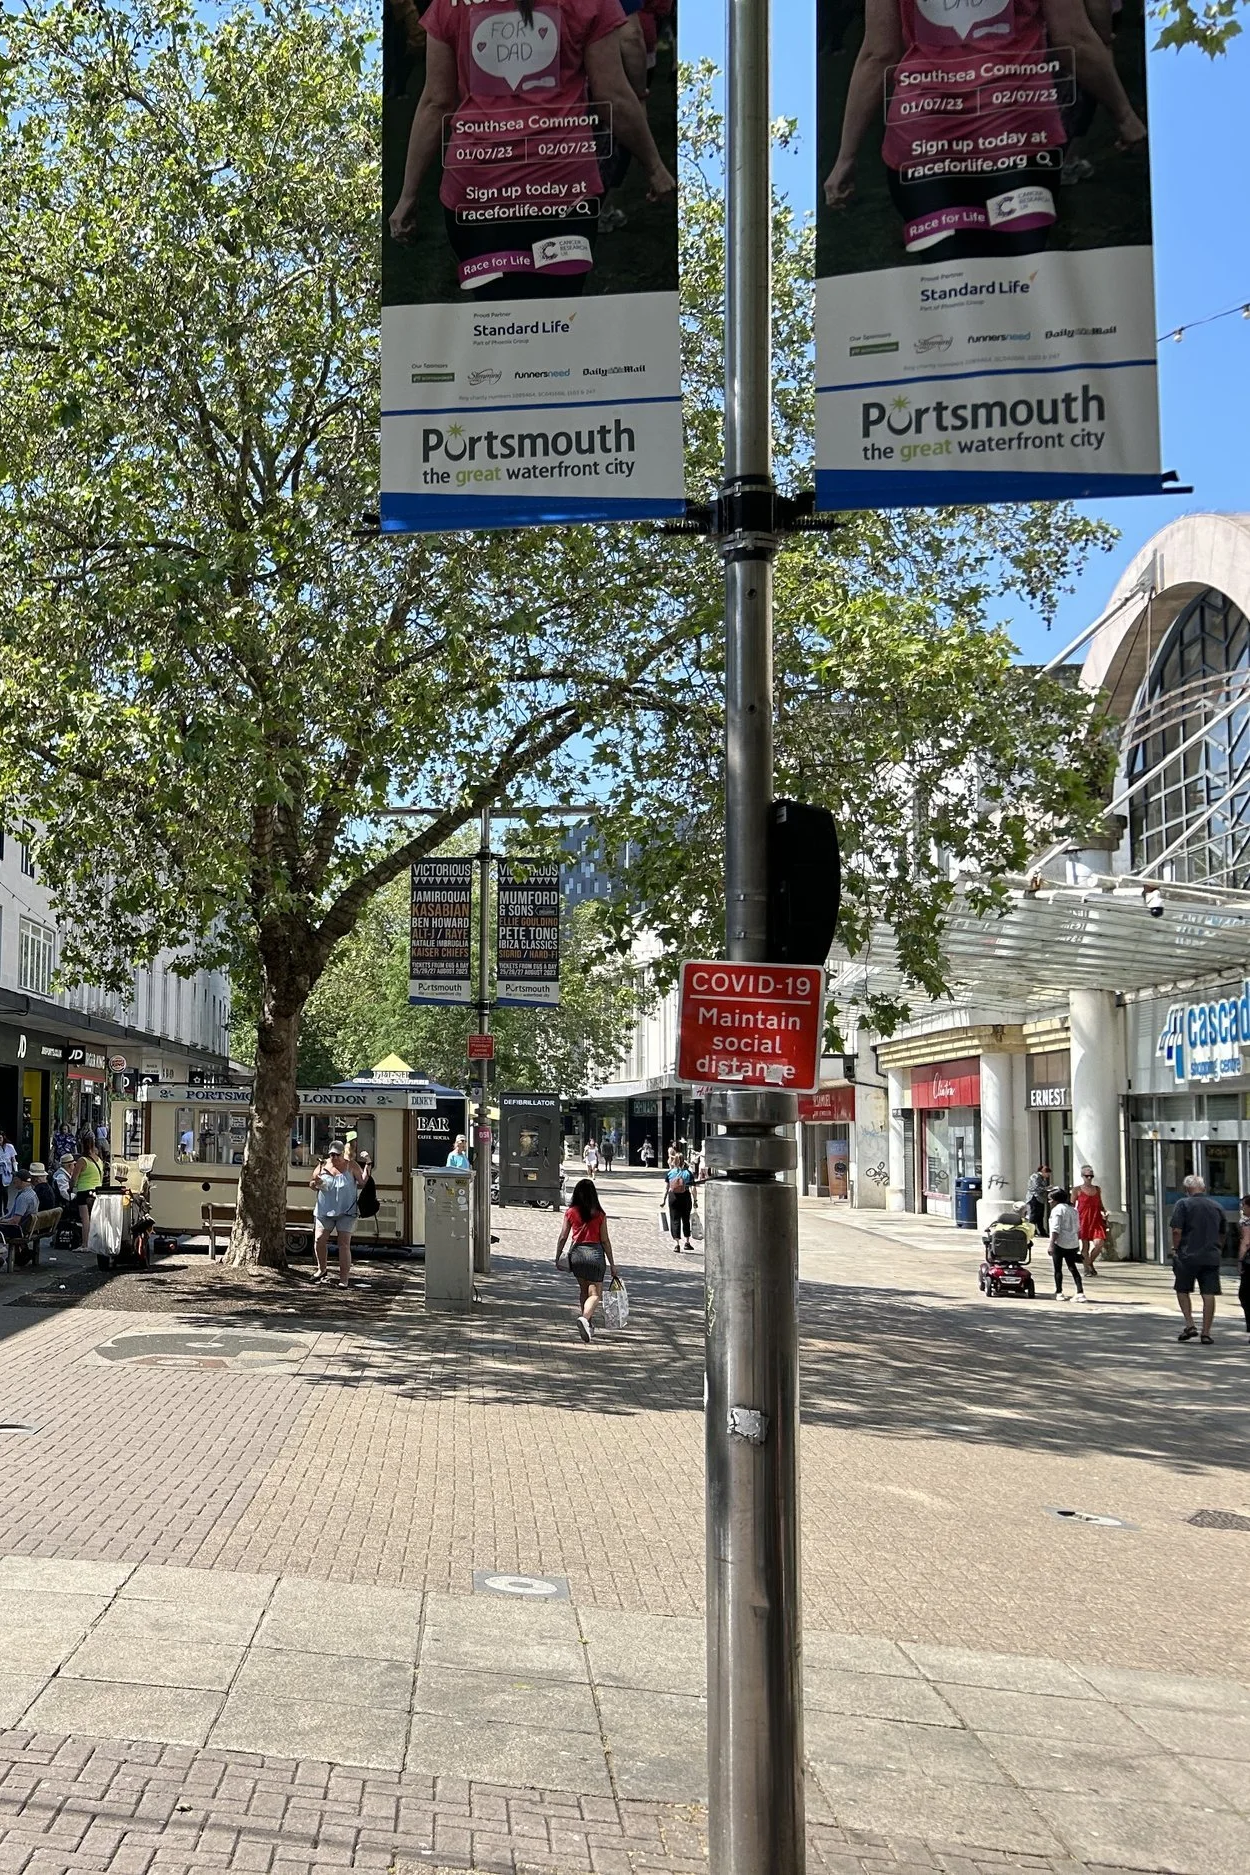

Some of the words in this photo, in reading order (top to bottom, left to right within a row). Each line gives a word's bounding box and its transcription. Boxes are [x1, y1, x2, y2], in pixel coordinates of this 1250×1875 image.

[491, 20, 526, 40] FOR
[497, 42, 533, 62] DAD
[900, 68, 976, 86] Southsea
[980, 60, 1060, 77] Common
[992, 88, 1058, 104] 02/07/23
[901, 98, 963, 114] 01/07/23
[455, 118, 524, 134] Southsea
[528, 113, 599, 129] Common
[538, 141, 597, 155] 02/07/23
[911, 140, 948, 155] Sign
[952, 139, 974, 152] up
[978, 131, 1027, 149] today
[1030, 131, 1048, 143] at
[456, 146, 513, 160] 01/07/23
[907, 154, 1027, 179] raceforlife.org
[466, 186, 498, 202] Sign
[502, 186, 521, 198] up
[525, 181, 568, 197] today
[571, 181, 587, 193] at
[462, 203, 568, 221] raceforlife.org
[909, 220, 939, 237] Race
[942, 214, 959, 224] for
[963, 211, 986, 222] Life
[463, 261, 489, 275] Race
[492, 257, 507, 267] for
[510, 255, 530, 266] Life
[920, 281, 996, 302] Standard
[999, 279, 1030, 294] Life
[473, 321, 539, 336] Standard
[542, 320, 570, 333] Life
[1045, 328, 1075, 339] Daily
[967, 331, 1031, 344] runnersneed
[515, 368, 570, 379] runnersneed
[583, 368, 608, 377] Daily
[624, 365, 646, 373] Mail
[862, 384, 1106, 438] Portsmouth
[422, 419, 635, 463] Portsmouth
[862, 443, 894, 461] the
[900, 438, 952, 462] great
[958, 432, 1064, 454] waterfront
[1070, 428, 1106, 450] city
[422, 468, 450, 484] the
[456, 466, 501, 487] great
[506, 460, 600, 480] waterfront
[605, 458, 635, 477] city
[413, 863, 471, 876] VICTORIOUS
[412, 891, 469, 903] JAMIROQUAI
[500, 891, 558, 905] MUMFORD
[412, 903, 469, 917] KASABIAN
[499, 905, 506, 916] &
[508, 904, 534, 916] SONS
[411, 917, 429, 928] BEN
[432, 917, 469, 928] HOWARD
[499, 917, 520, 926] ELLIE
[521, 917, 558, 926] GOULDING
[412, 929, 435, 939] ALT-J
[445, 929, 468, 939] RAYE
[500, 927, 526, 939] PETE
[529, 927, 558, 940] TONG
[411, 947, 440, 957] KAISER
[441, 947, 469, 957] CHIEFS
[499, 940, 519, 949] IBIZA
[521, 940, 558, 950] CLASSICS
[499, 950, 521, 958] SIGRID
[418, 983, 462, 991] Portsmouth
[506, 984, 550, 992] Portsmouth
[692, 972, 811, 996] COVID-19
[698, 1006, 801, 1031] Maintain
[17, 1034, 27, 1058] JD
[712, 1034, 782, 1054] social
[68, 1049, 83, 1060] JD
[186, 1090, 253, 1100] PORTSMO
[303, 1093, 367, 1105] LONDON
[503, 1099, 555, 1107] DEFIBRILLATOR
[1030, 1087, 1067, 1106] ERNEST
[417, 1117, 450, 1132] BAR
